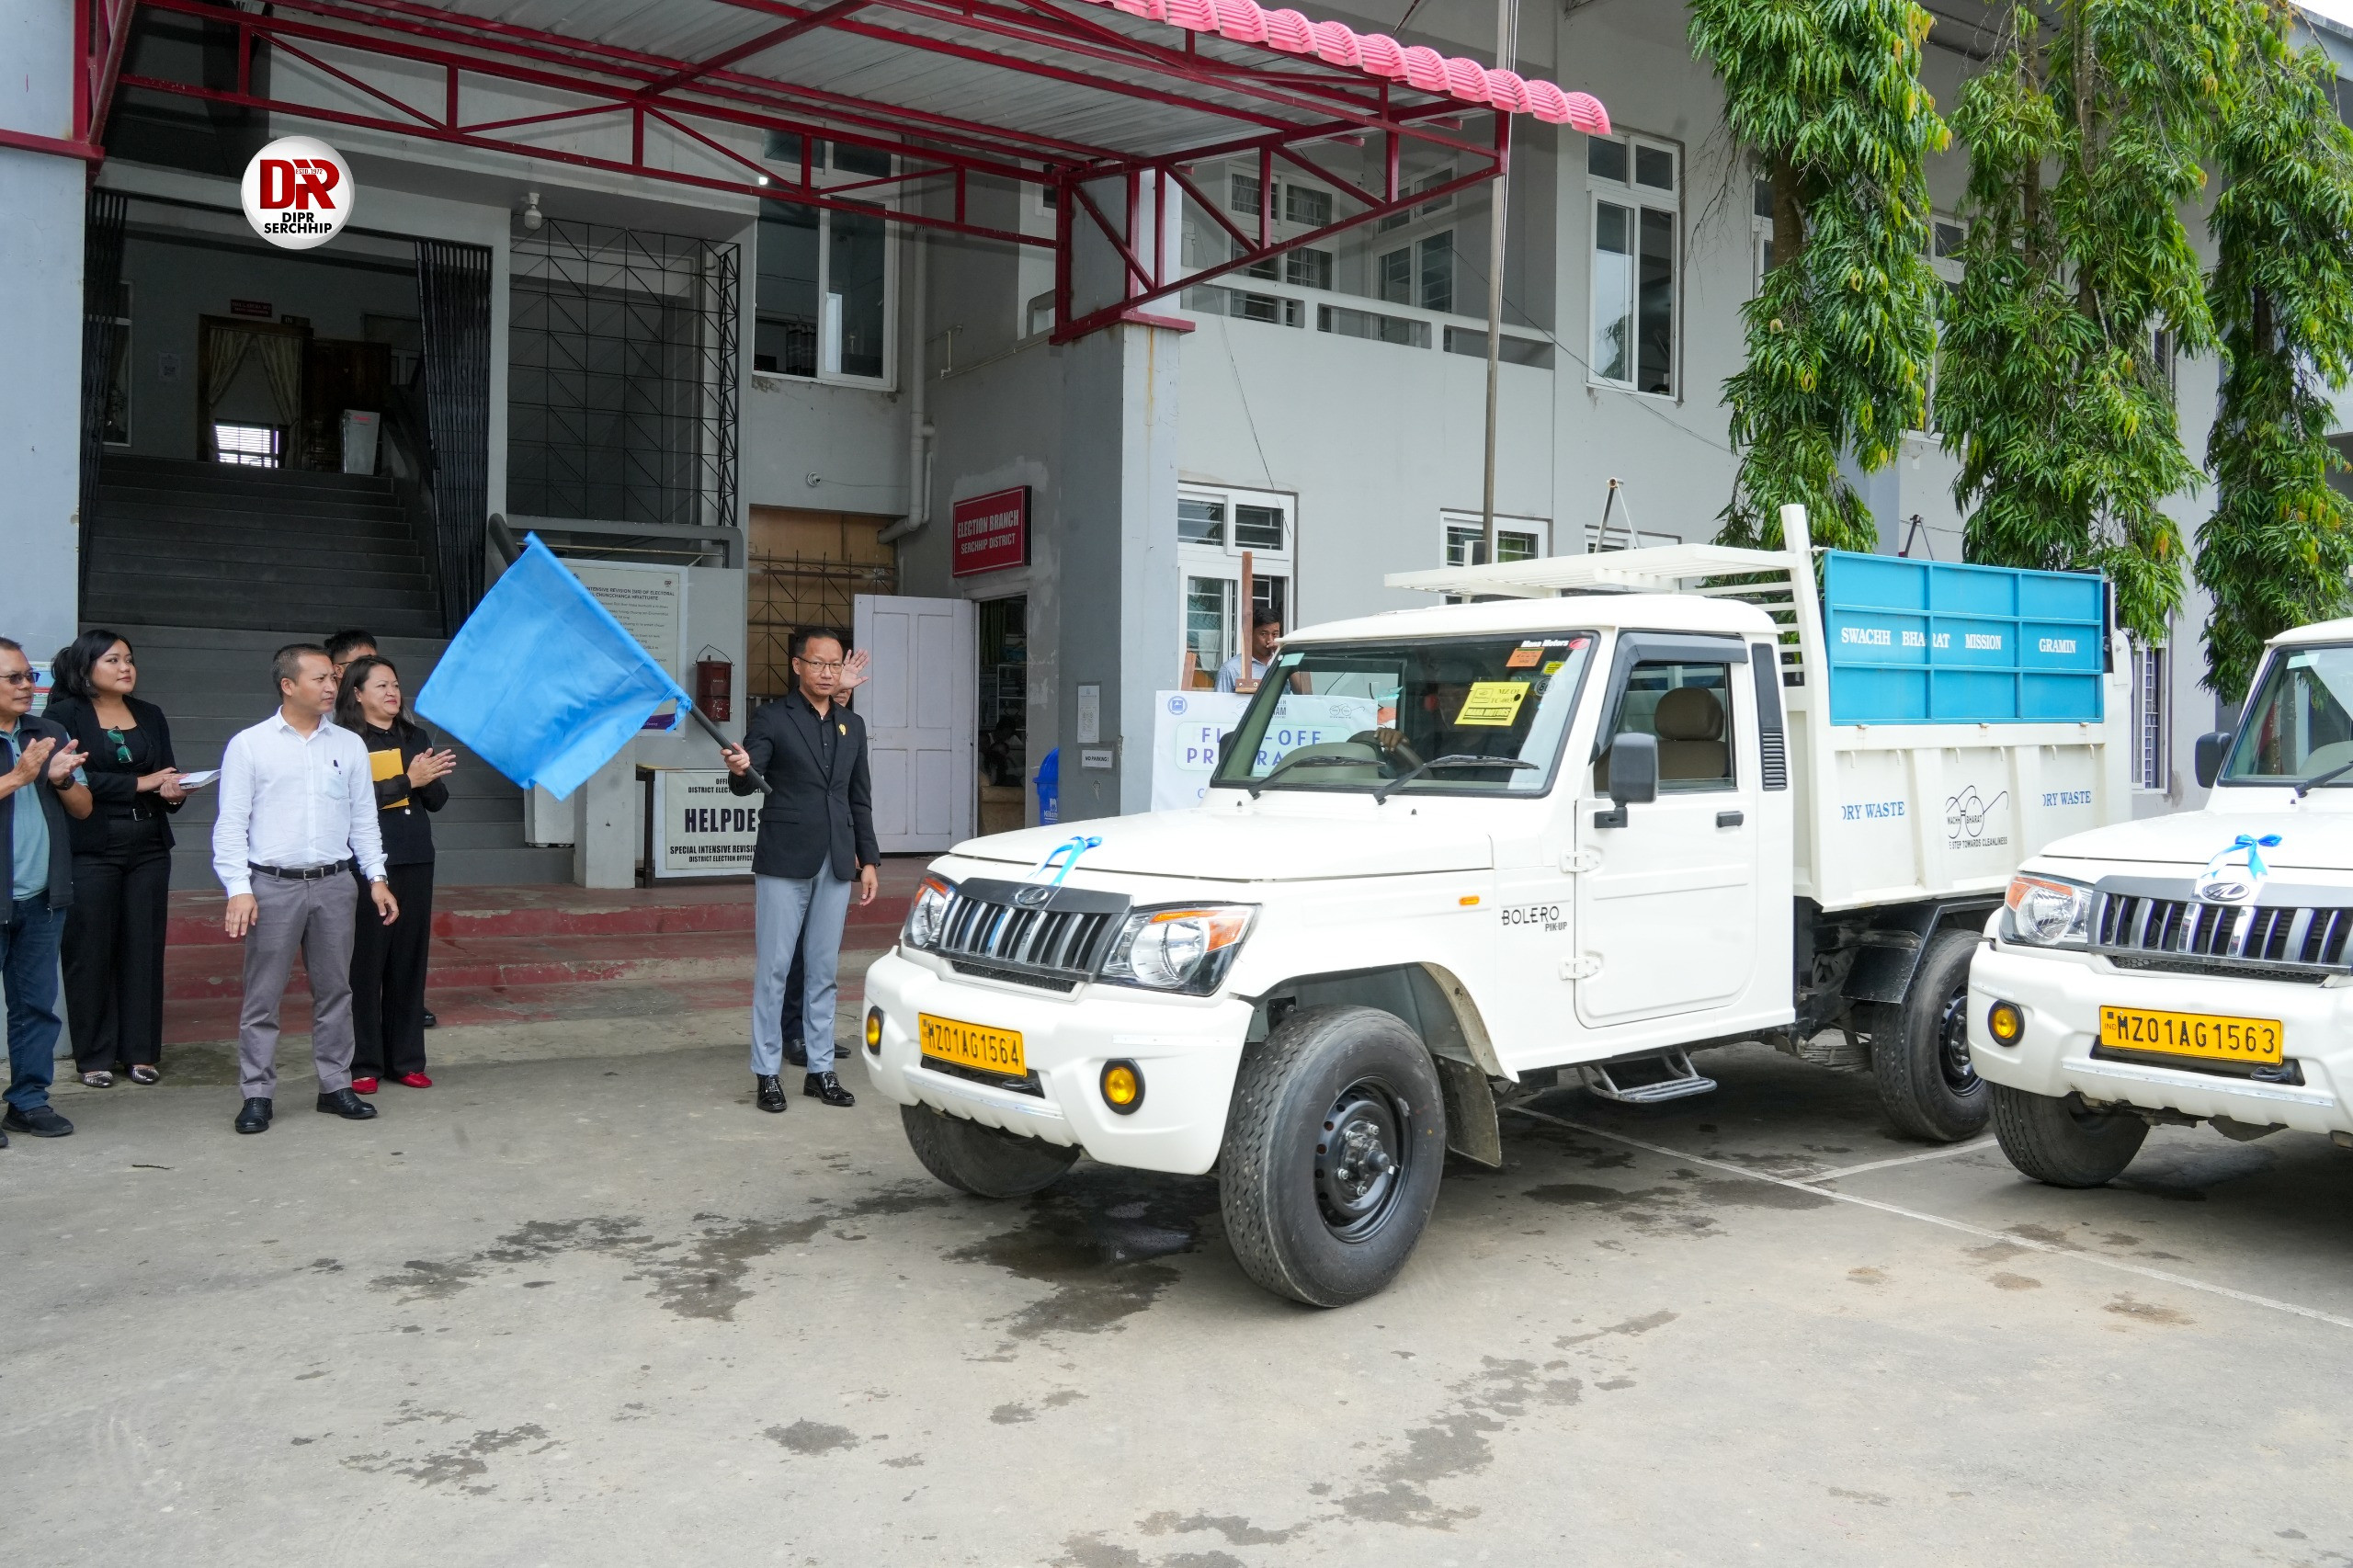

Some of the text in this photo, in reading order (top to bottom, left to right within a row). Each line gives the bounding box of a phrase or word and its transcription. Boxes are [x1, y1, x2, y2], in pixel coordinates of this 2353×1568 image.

[957, 509, 1019, 539] ELECTION BRANCH
[961, 533, 1016, 555] SERCHHIP DISTRICT
[1541, 639, 1569, 647] Motors
[1841, 627, 1891, 645] SWACHH
[1965, 633, 2001, 651] MISSION
[2039, 638, 2075, 653] GRAMIN
[2060, 790, 2091, 806] WASTE
[1866, 801, 1904, 818] WASTE
[1947, 815, 1961, 825] WACHH
[685, 808, 759, 833] HELPDE
[670, 845, 756, 855] SPECIAL INTENSIVE REVISIO
[1952, 840, 1961, 849] STEP
[1962, 838, 1981, 848] TOWARDS
[1982, 836, 2007, 846] CLEANLINESS
[1501, 905, 1560, 926] BOLERO
[927, 1022, 1019, 1066] MZ01AG1564
[2104, 1015, 2275, 1054] IND MZ01AG1563
